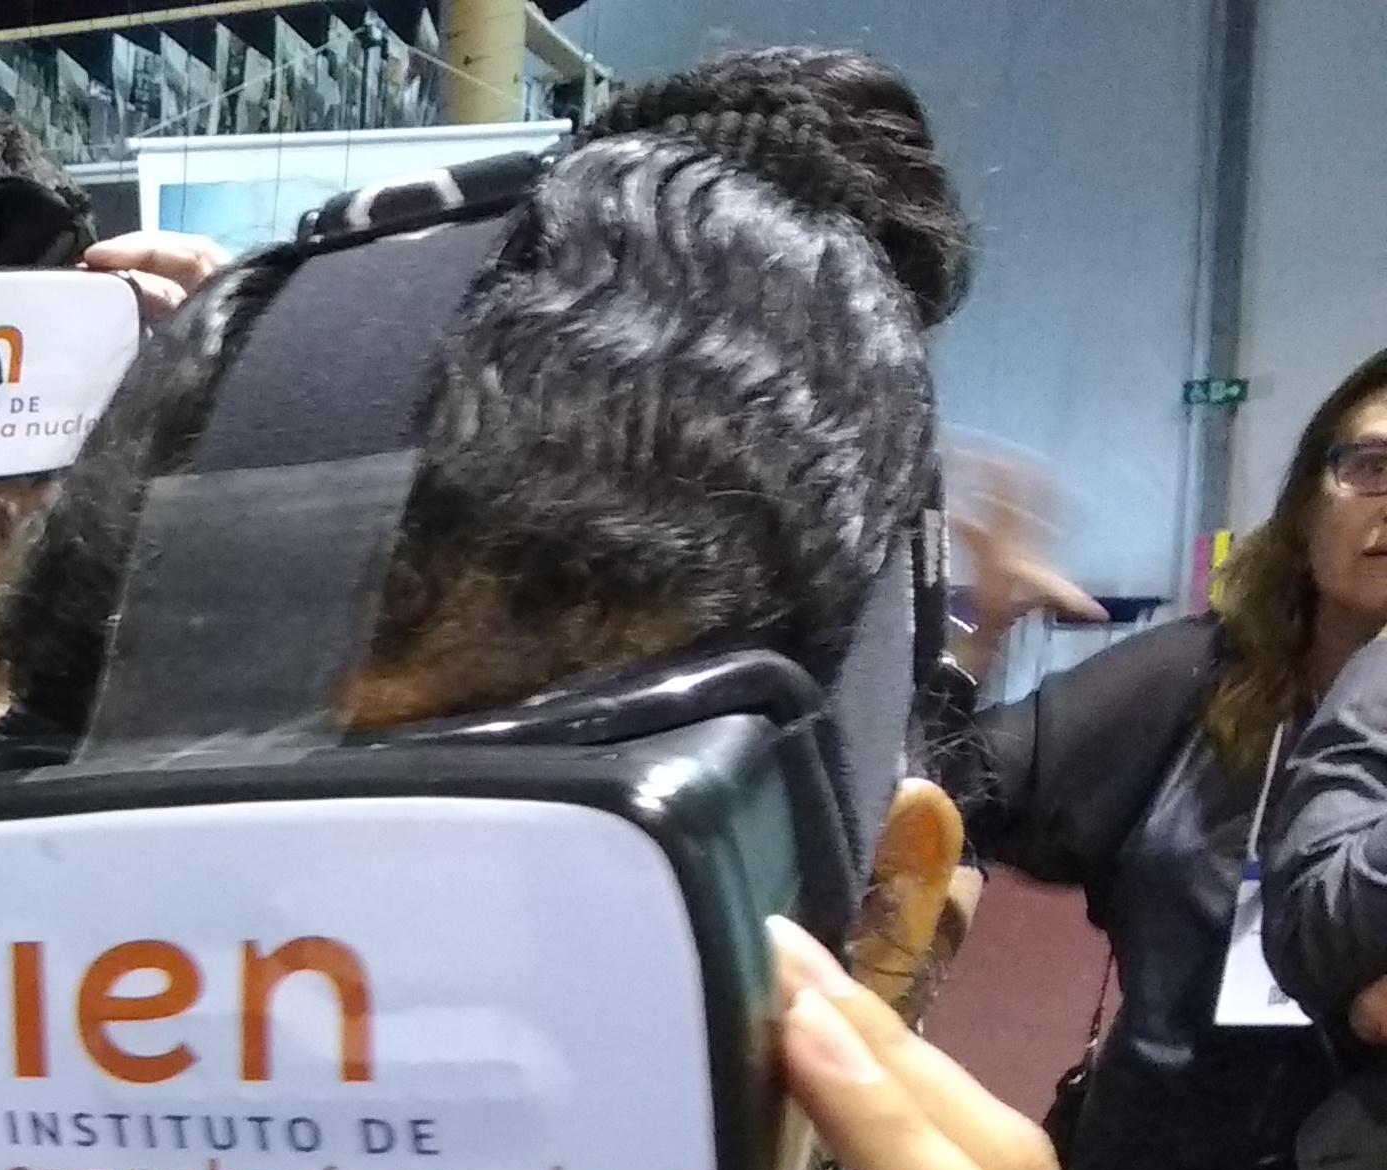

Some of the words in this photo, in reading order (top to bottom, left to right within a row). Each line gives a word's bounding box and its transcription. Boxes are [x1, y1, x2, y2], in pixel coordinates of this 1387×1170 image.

[10, 396, 41, 415] DE
[25, 414, 100, 438] nucle
[4, 1110, 323, 1153] INSTITUTO
[359, 1117, 441, 1156] DE
